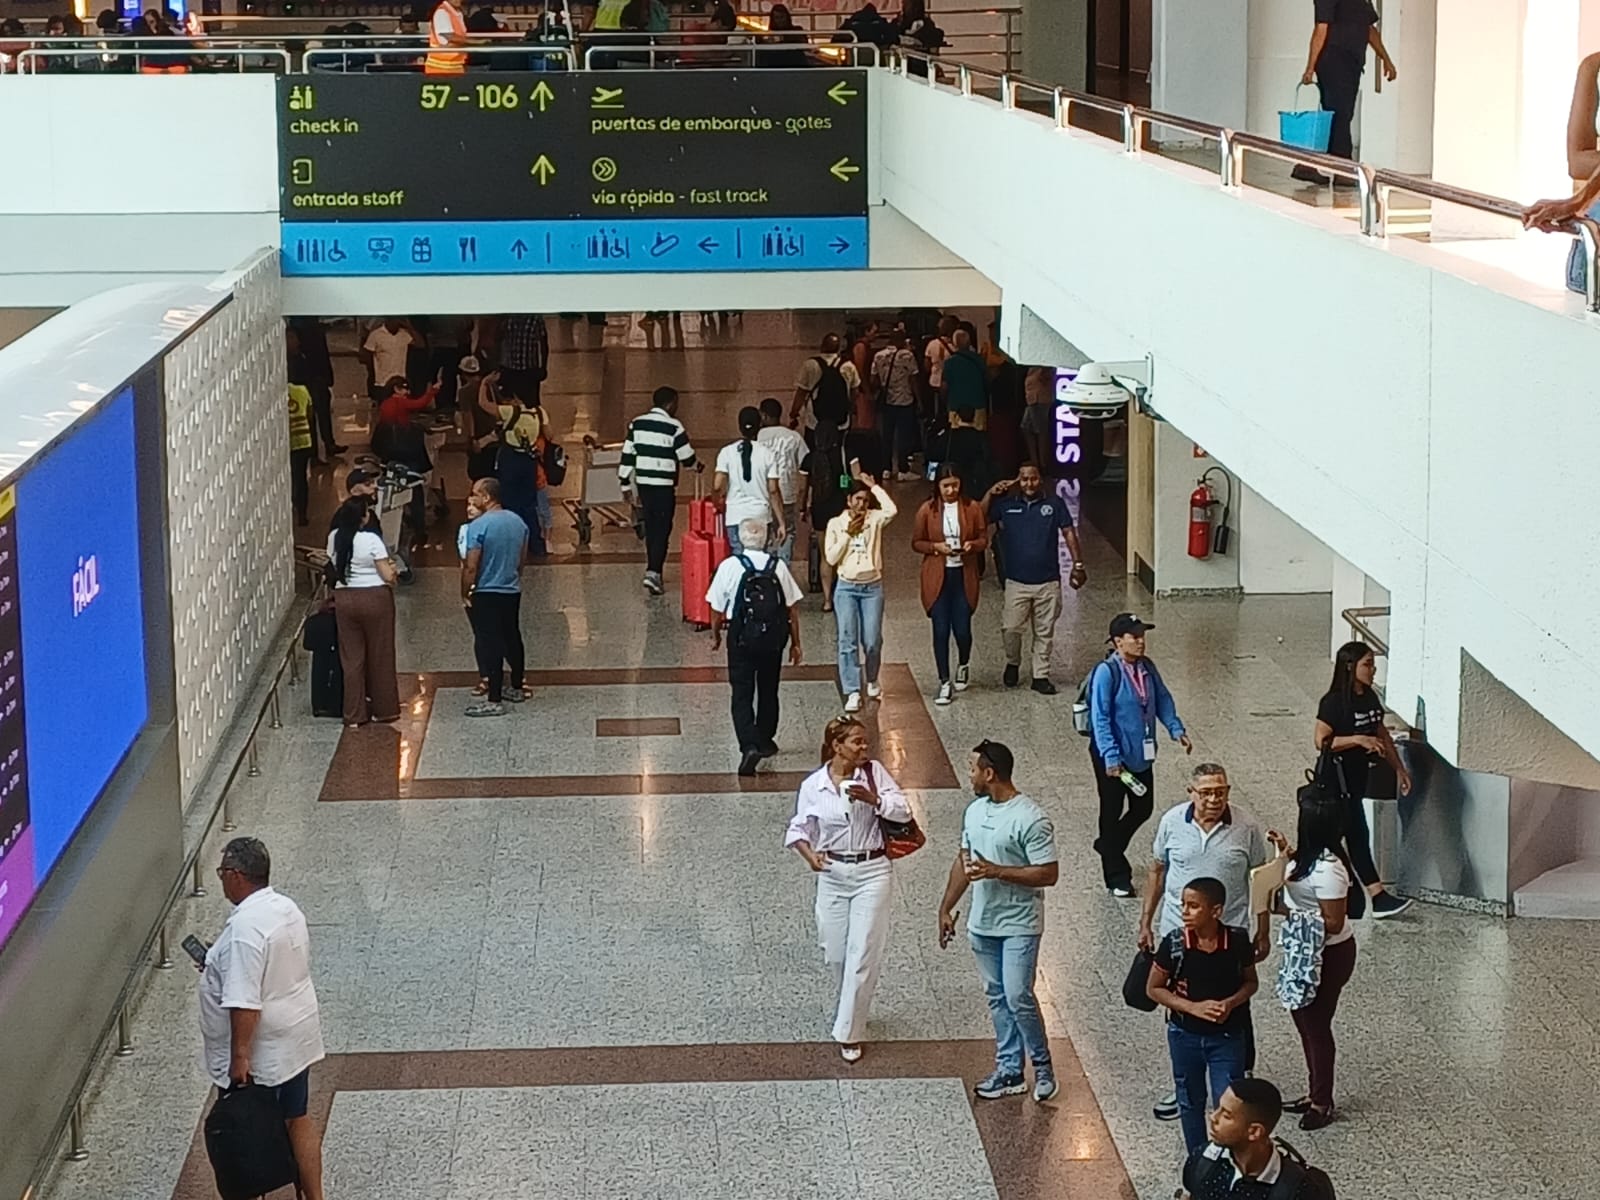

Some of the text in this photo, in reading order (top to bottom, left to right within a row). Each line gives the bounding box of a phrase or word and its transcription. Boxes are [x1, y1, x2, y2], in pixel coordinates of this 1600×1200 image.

[420, 84, 451, 109] 57
[475, 84, 519, 109] 106
[289, 117, 359, 134] check in
[591, 118, 656, 134] puertas
[659, 116, 681, 131] de
[684, 116, 773, 134] embarque
[785, 116, 832, 136] gates
[292, 190, 404, 207] entrada staff
[620, 188, 675, 207] rápida
[690, 188, 722, 204] fast
[725, 188, 769, 203] track
